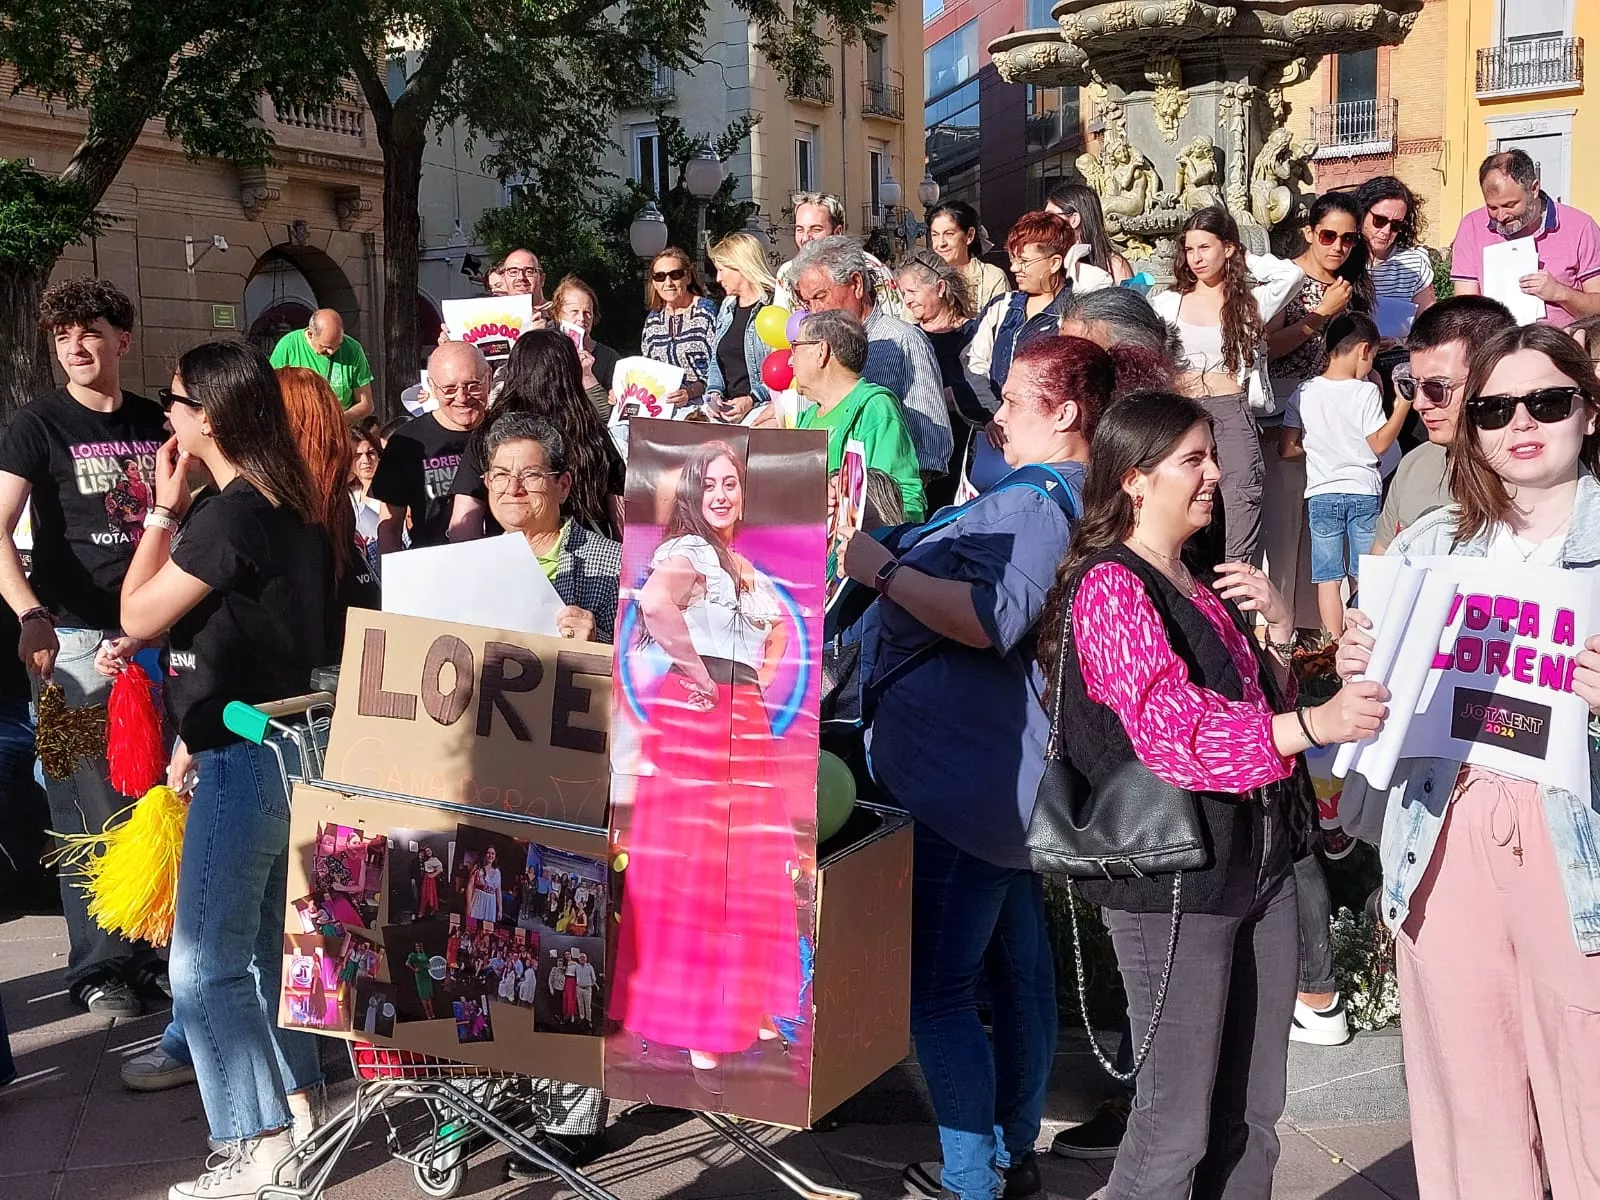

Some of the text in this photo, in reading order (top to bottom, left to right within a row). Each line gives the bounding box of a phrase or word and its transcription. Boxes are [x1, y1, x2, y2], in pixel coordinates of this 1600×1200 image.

[69, 441, 132, 458] LORENA
[74, 456, 122, 476] FINA
[423, 454, 463, 470] LOREN
[426, 481, 453, 500] LIS
[91, 531, 130, 545] VOTA
[356, 573, 374, 585] VO
[1444, 592, 1576, 647] VOTA A
[357, 627, 613, 754] LORE
[1460, 703, 1544, 735] JOTALENT
[1485, 723, 1516, 738] 2024
